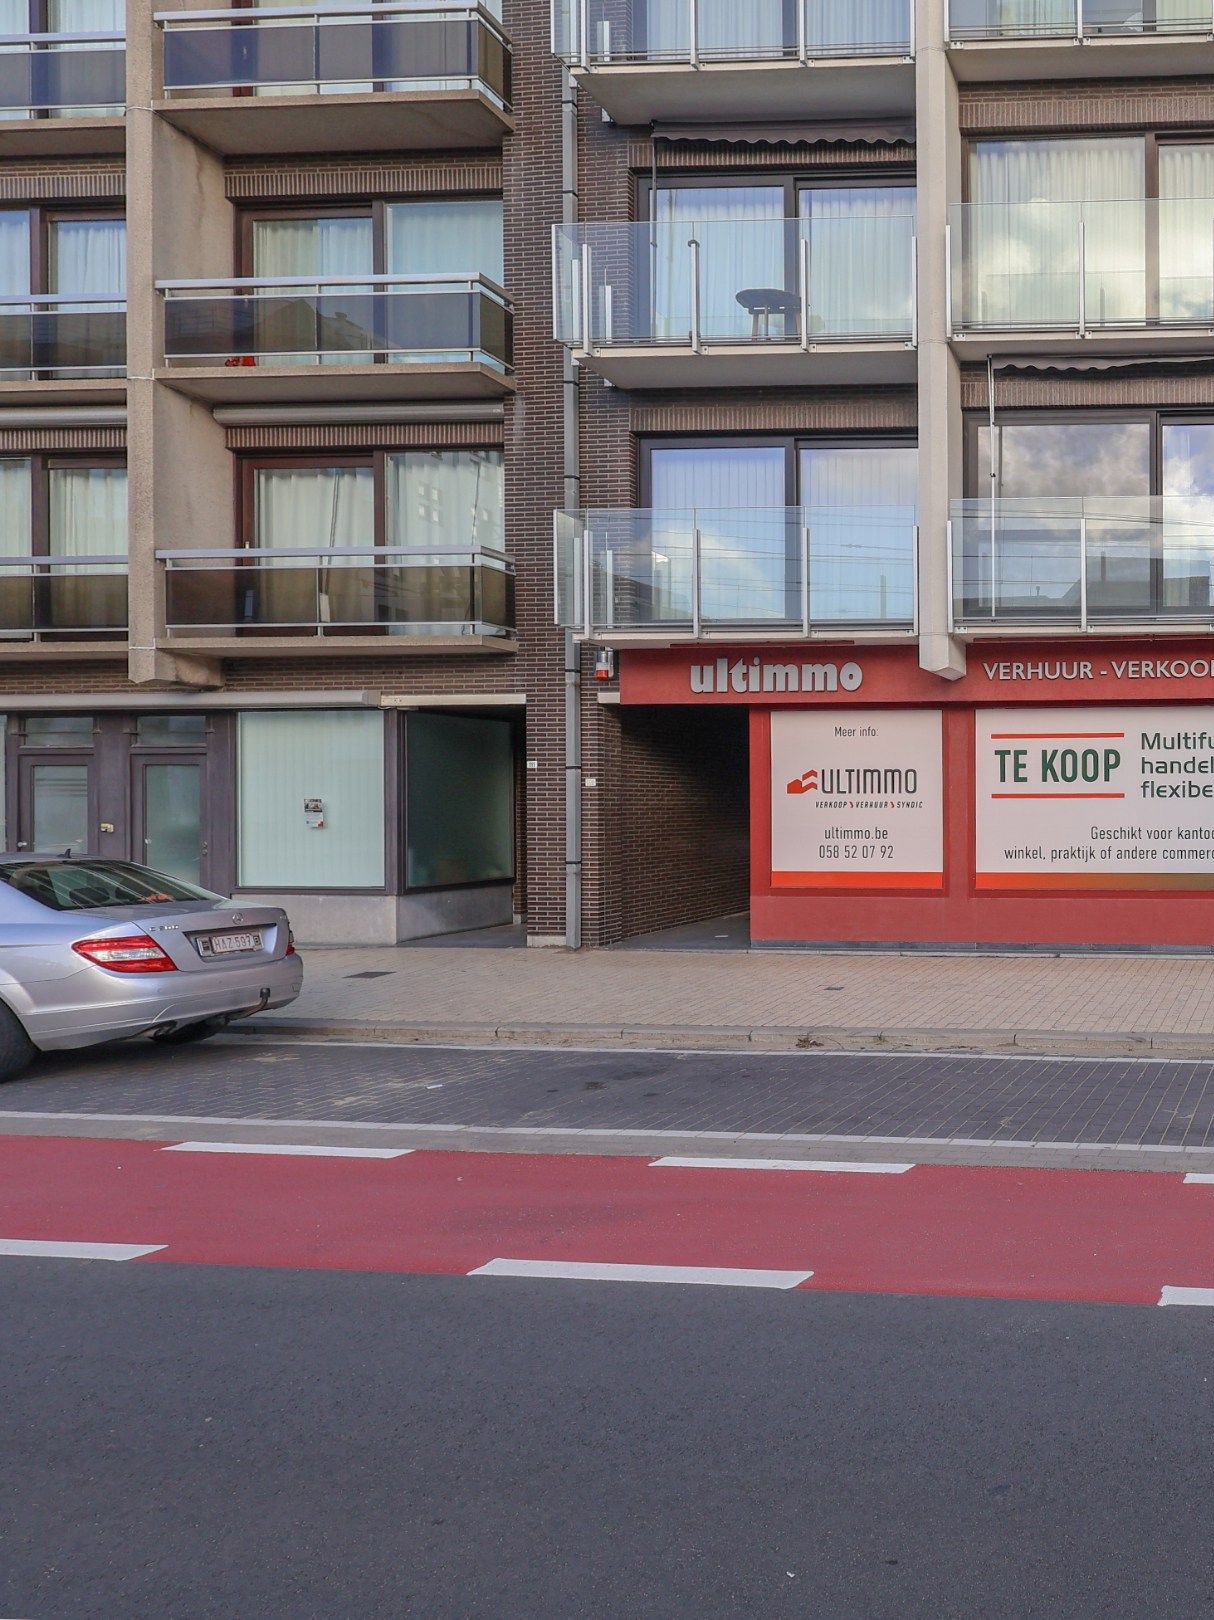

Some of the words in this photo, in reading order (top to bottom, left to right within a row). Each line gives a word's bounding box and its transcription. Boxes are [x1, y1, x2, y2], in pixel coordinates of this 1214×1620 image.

[690, 656, 863, 693] ultimmo
[983, 662, 1094, 680] VERHUUR
[834, 726, 856, 737] Meer
[859, 725, 879, 737] info:
[994, 750, 1027, 783] TE
[1042, 749, 1121, 783] KOOP
[821, 768, 917, 795] ULTIMMO
[815, 801, 848, 809] VERKOOP
[856, 801, 888, 809] VERHUUR
[897, 801, 923, 809] SYNDIC
[824, 827, 888, 840] ultimmo.be
[1090, 826, 1143, 840] Geschikt
[1147, 829, 1173, 840] voor
[819, 845, 840, 859] 058
[844, 845, 858, 859] 52
[862, 845, 876, 859] 07
[880, 845, 894, 859] 92
[1004, 845, 1046, 861] winkel,
[1050, 845, 1096, 863] praktijk
[1100, 845, 1113, 860] of
[1116, 845, 1157, 860] andere
